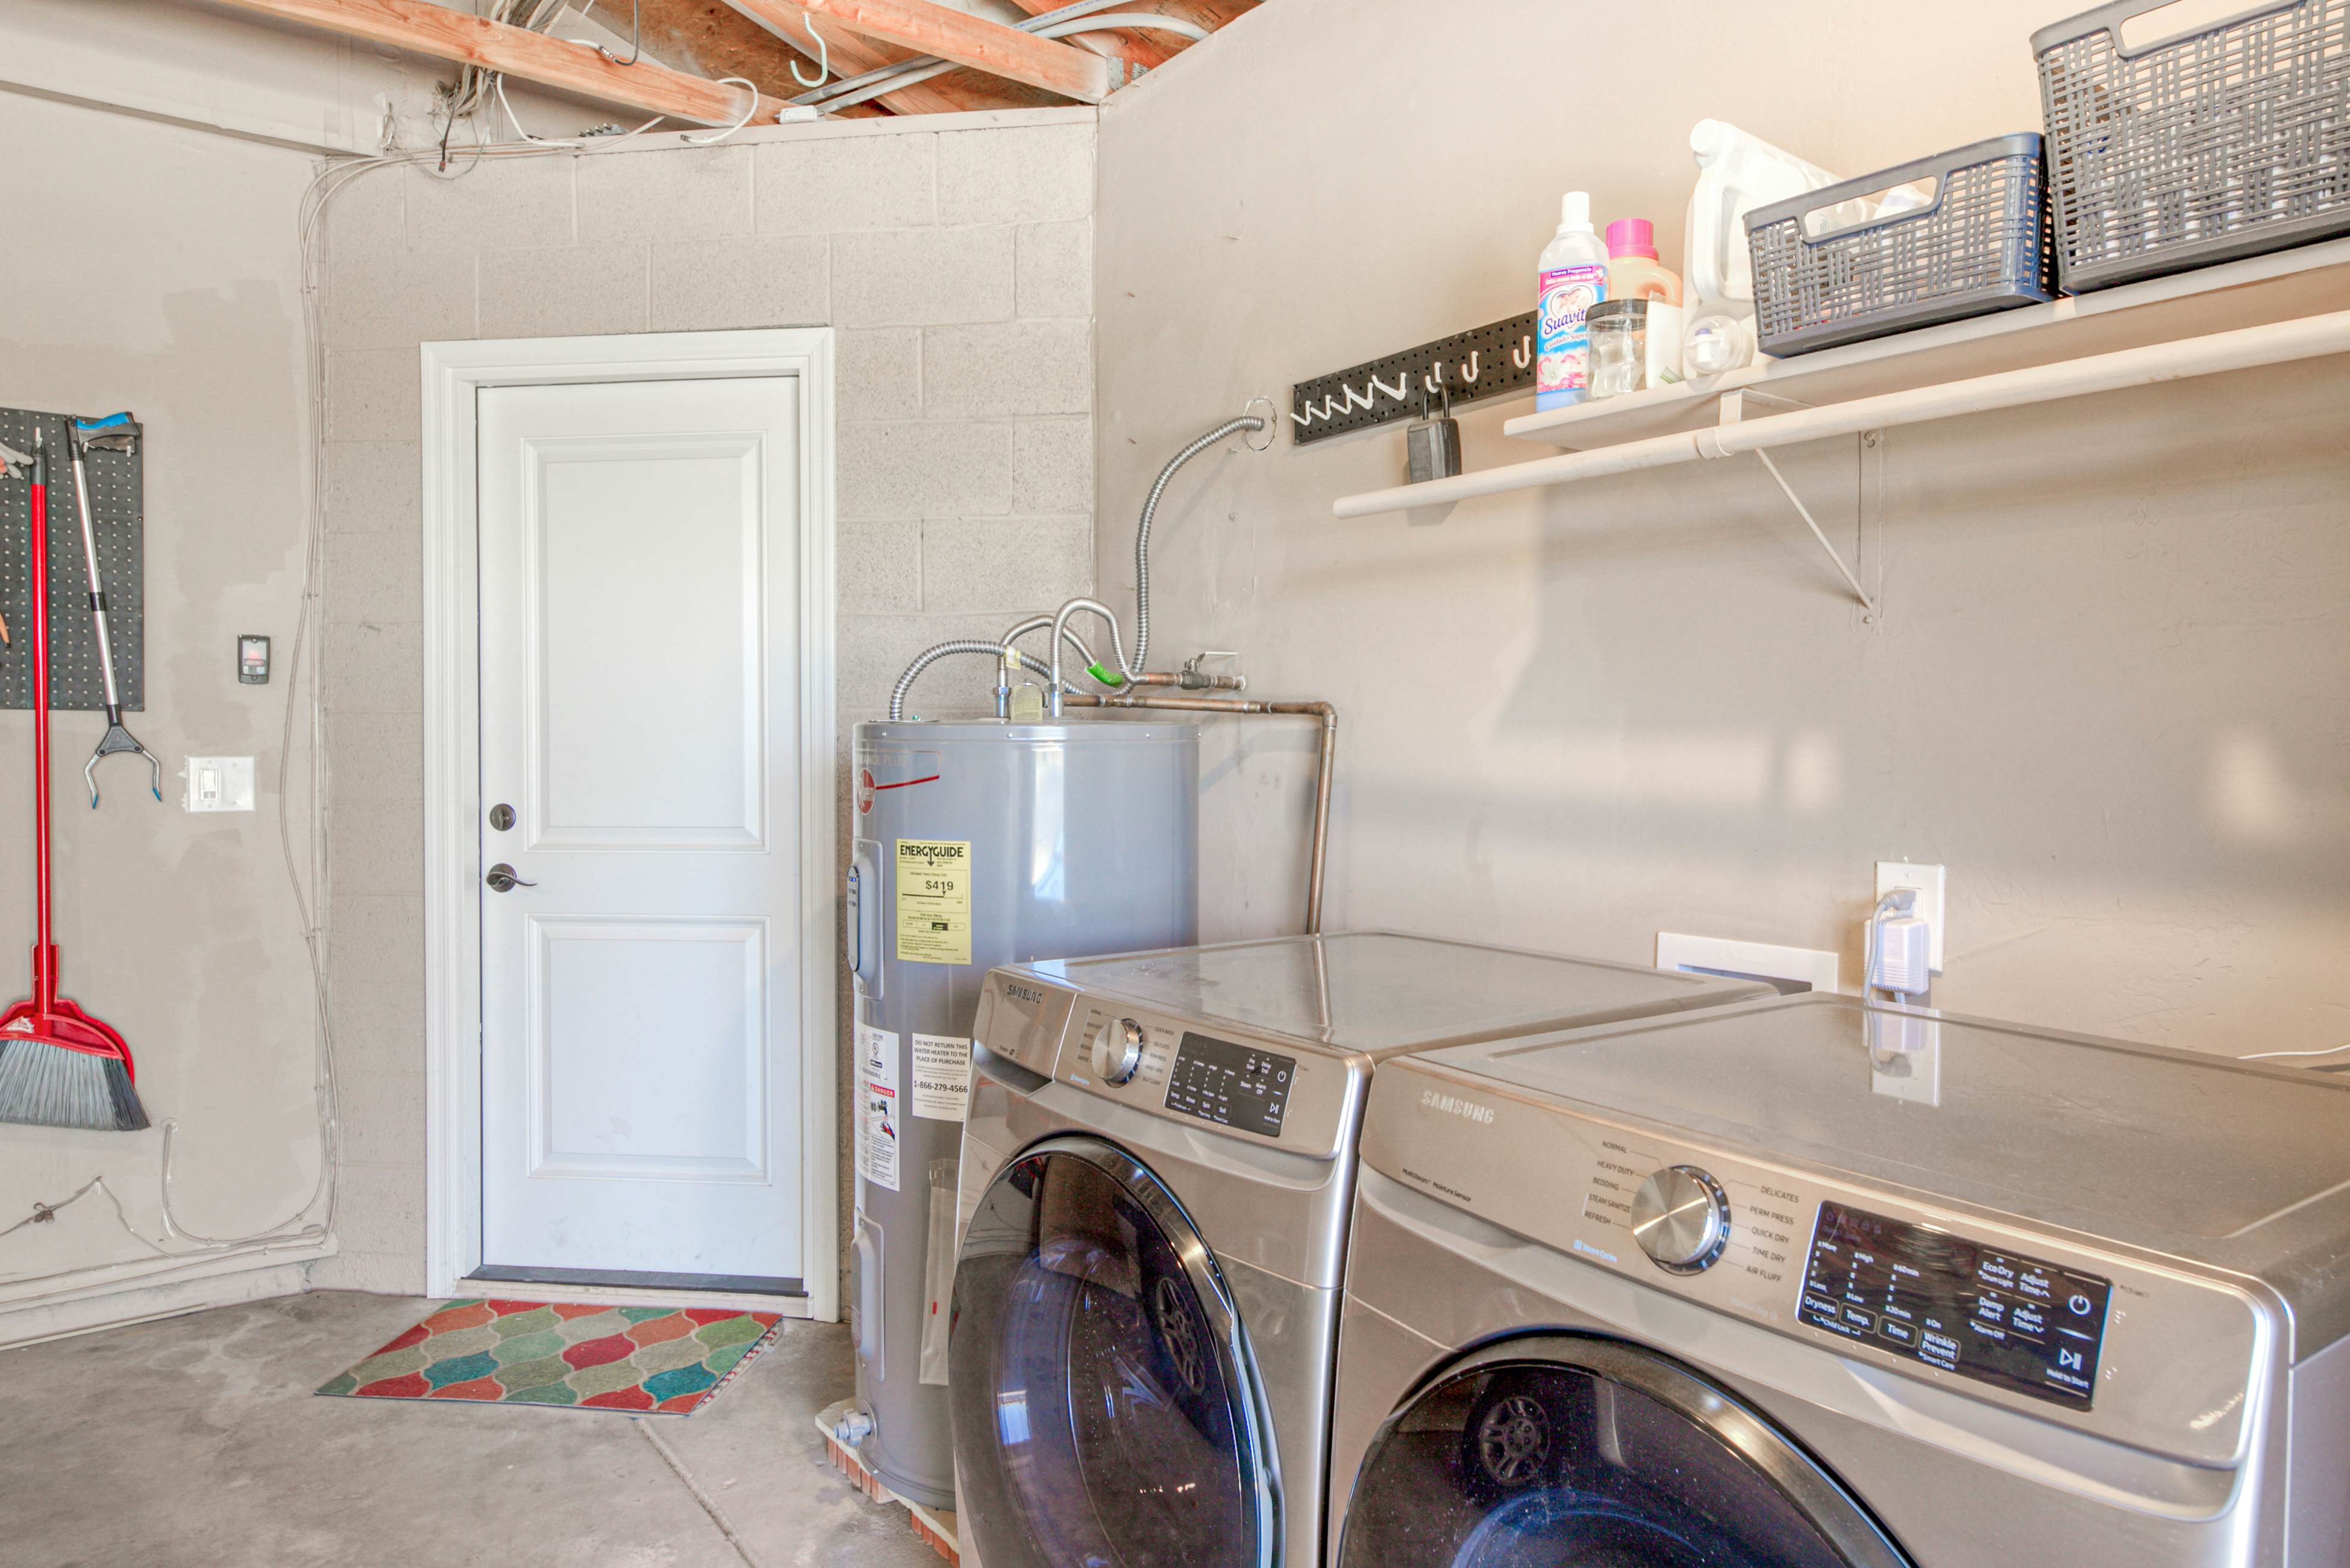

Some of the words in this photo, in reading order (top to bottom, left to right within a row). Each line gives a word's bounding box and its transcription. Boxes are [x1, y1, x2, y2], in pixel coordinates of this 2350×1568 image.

[1544, 308, 1587, 335] Suavit
[900, 845, 964, 858] ENERGYGUIDE
[926, 880, 953, 891] $419
[1007, 984, 1042, 1004] SAMSUNG
[874, 1085, 894, 1096] DANGER
[913, 1079, 968, 1093] 1-866-279-4566
[1421, 1089, 1494, 1125] SAMSUNG
[1602, 1140, 1628, 1154] NORMAL
[1597, 1159, 1618, 1171] HEAVY
[1617, 1165, 1635, 1176] DUTY
[1432, 1181, 1454, 1196] Moisture
[1453, 1190, 1471, 1202] Sensor
[1593, 1176, 1620, 1191] BEDDING
[1761, 1185, 1800, 1204] DELICATES
[1588, 1193, 1608, 1205] STEAM
[1608, 1200, 1632, 1214] SANITIZE
[1585, 1210, 1612, 1225] REFRESH
[1749, 1206, 1770, 1219] PERM
[1771, 1212, 1794, 1225] PRESS
[1751, 1226, 1774, 1240] QUICK
[1774, 1233, 1790, 1245] DRY
[1752, 1246, 1770, 1259] TIME
[1770, 1252, 1786, 1264] DRY
[1746, 1266, 1758, 1276] AIR
[1759, 1269, 1782, 1283] FLUFF
[2020, 1272, 2050, 1288] Adjust
[2020, 1281, 2040, 1296] Time
[1805, 1296, 1837, 1314] Dryness
[1979, 1296, 2005, 1313] Damp
[1846, 1309, 1870, 1326] Temp.
[1978, 1307, 2002, 1322] Alert
[2013, 1307, 2044, 1325] Adjust
[1887, 1323, 1910, 1340] Time
[2013, 1316, 2034, 1332] Time
[1924, 1331, 1958, 1351] Wrinkle
[1922, 1340, 1956, 1360] Prevent
[2046, 1367, 2063, 1380] Hold
[2071, 1376, 2090, 1389] Start
